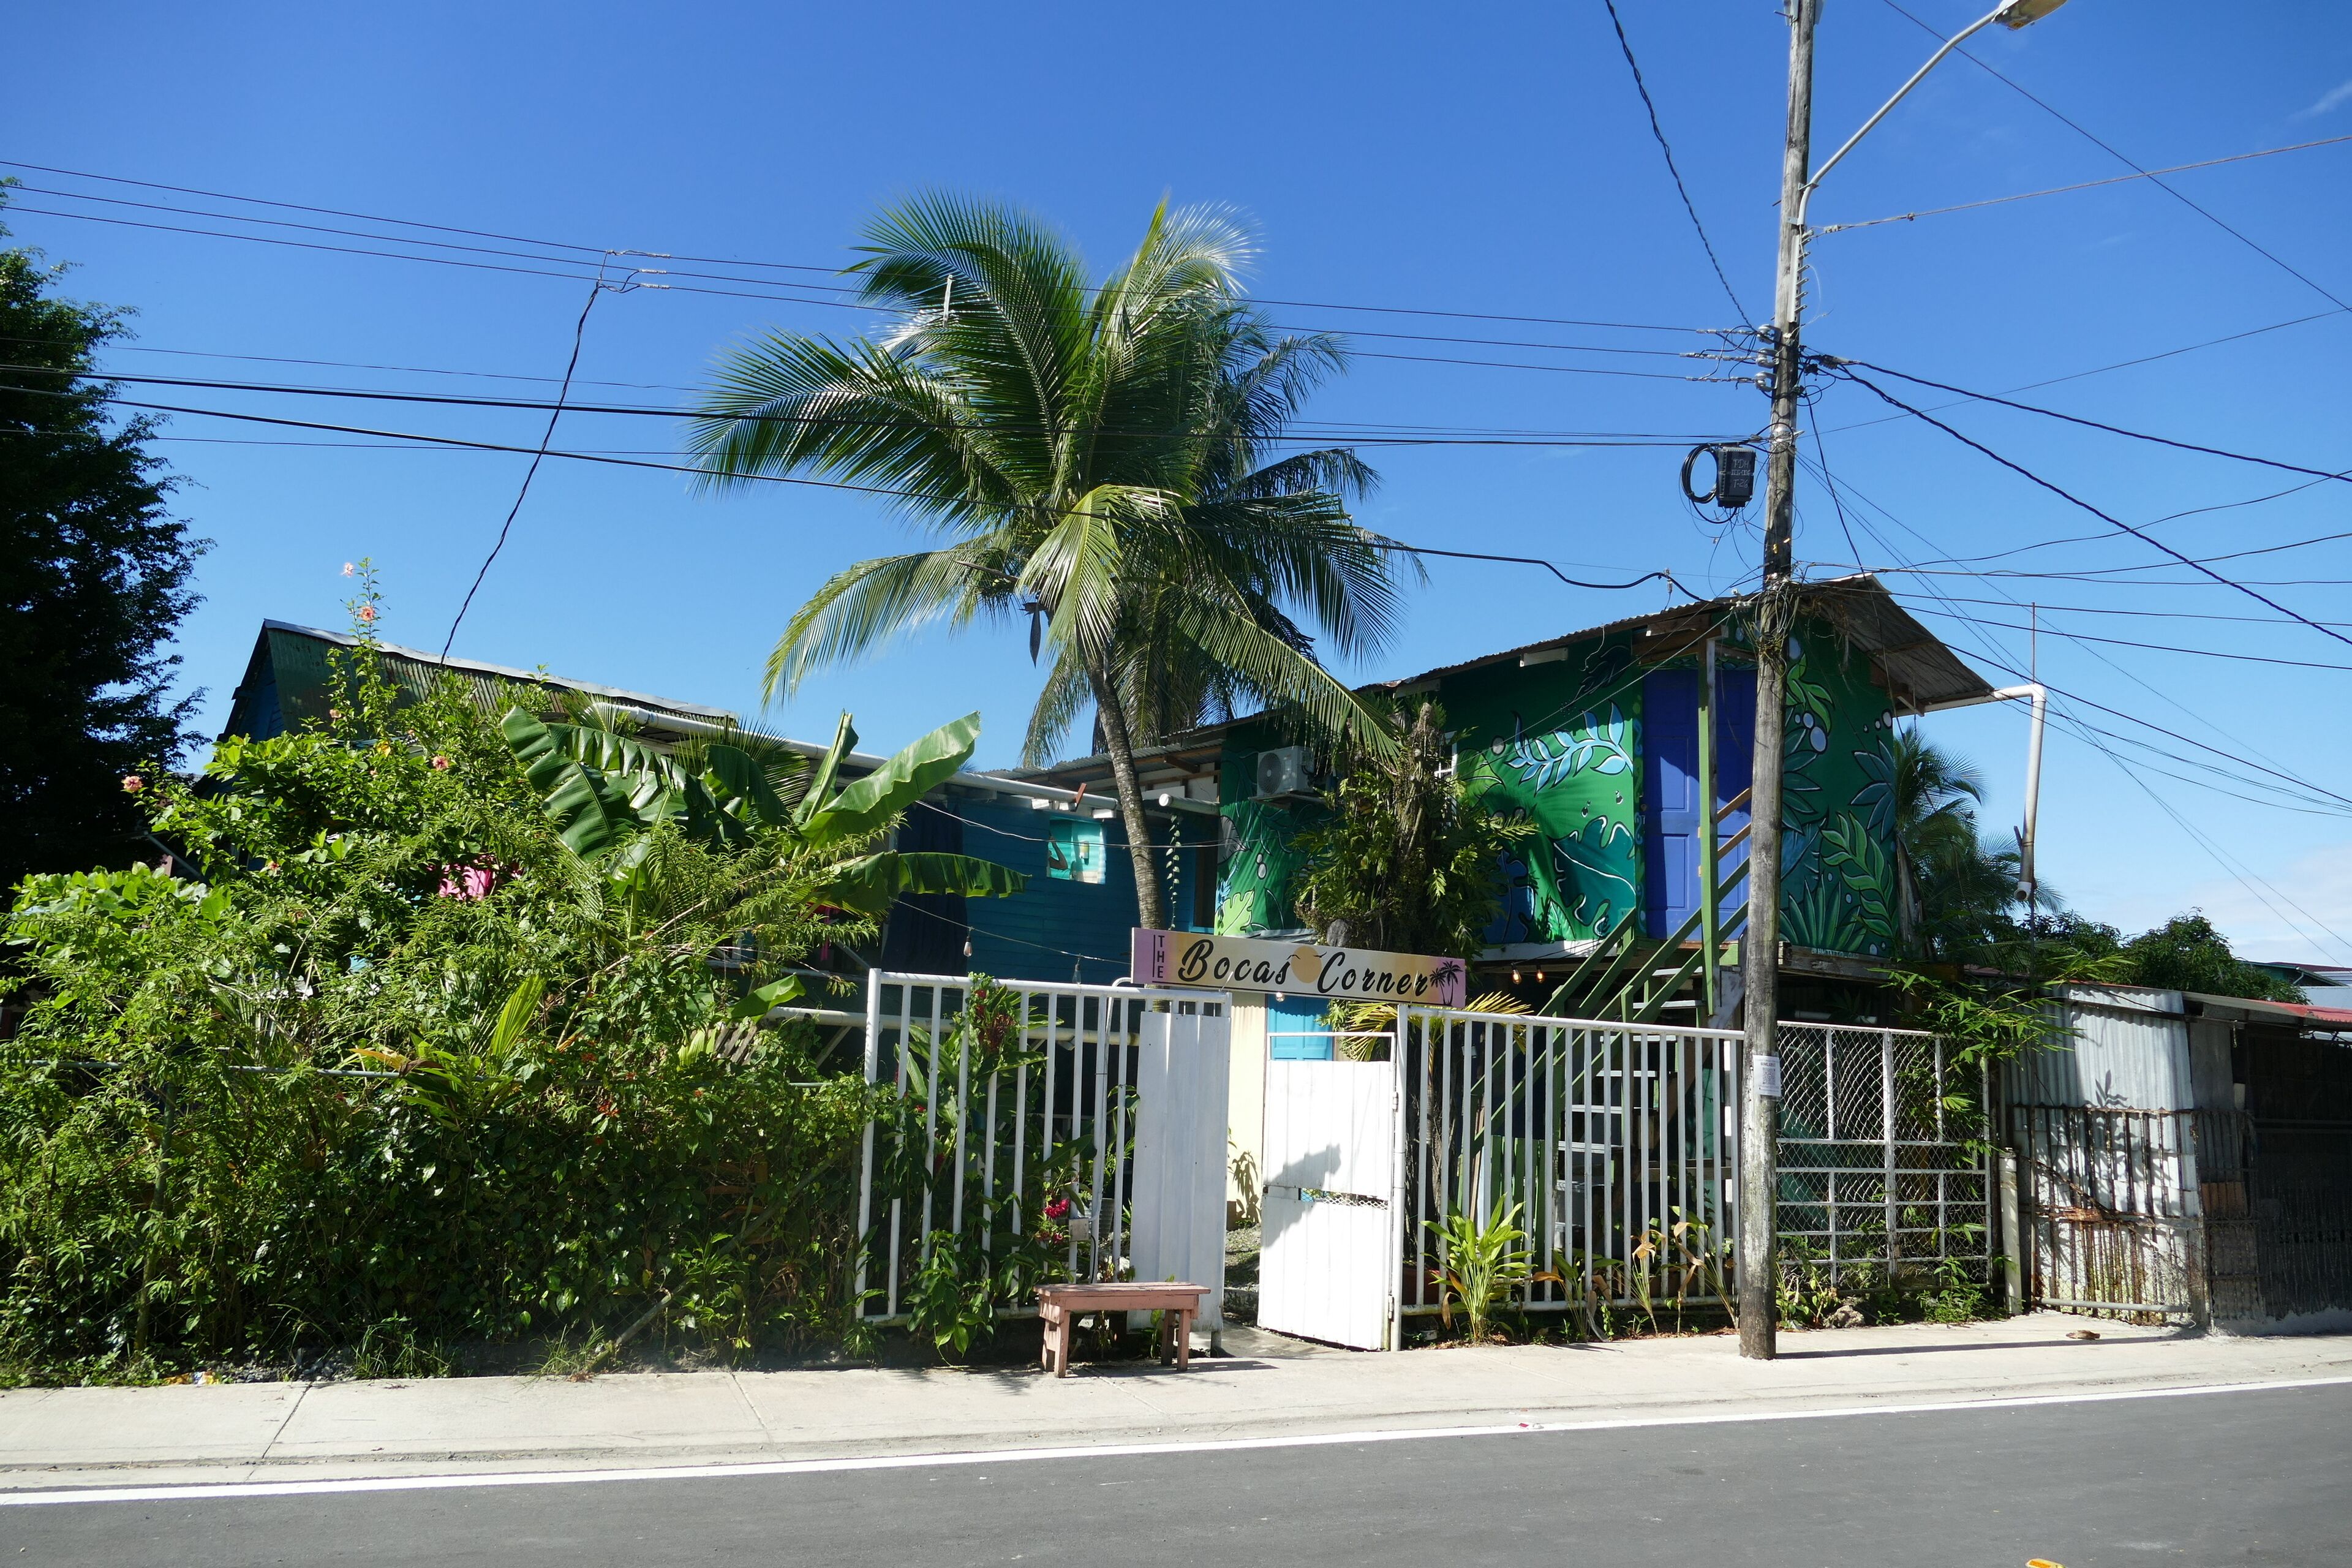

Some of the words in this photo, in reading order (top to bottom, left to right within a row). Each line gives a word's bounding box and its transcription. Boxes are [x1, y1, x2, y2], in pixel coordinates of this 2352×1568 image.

[1156, 935, 1165, 979] THE
[1178, 938, 1291, 985] Bocas
[1317, 951, 1428, 997] Corner
